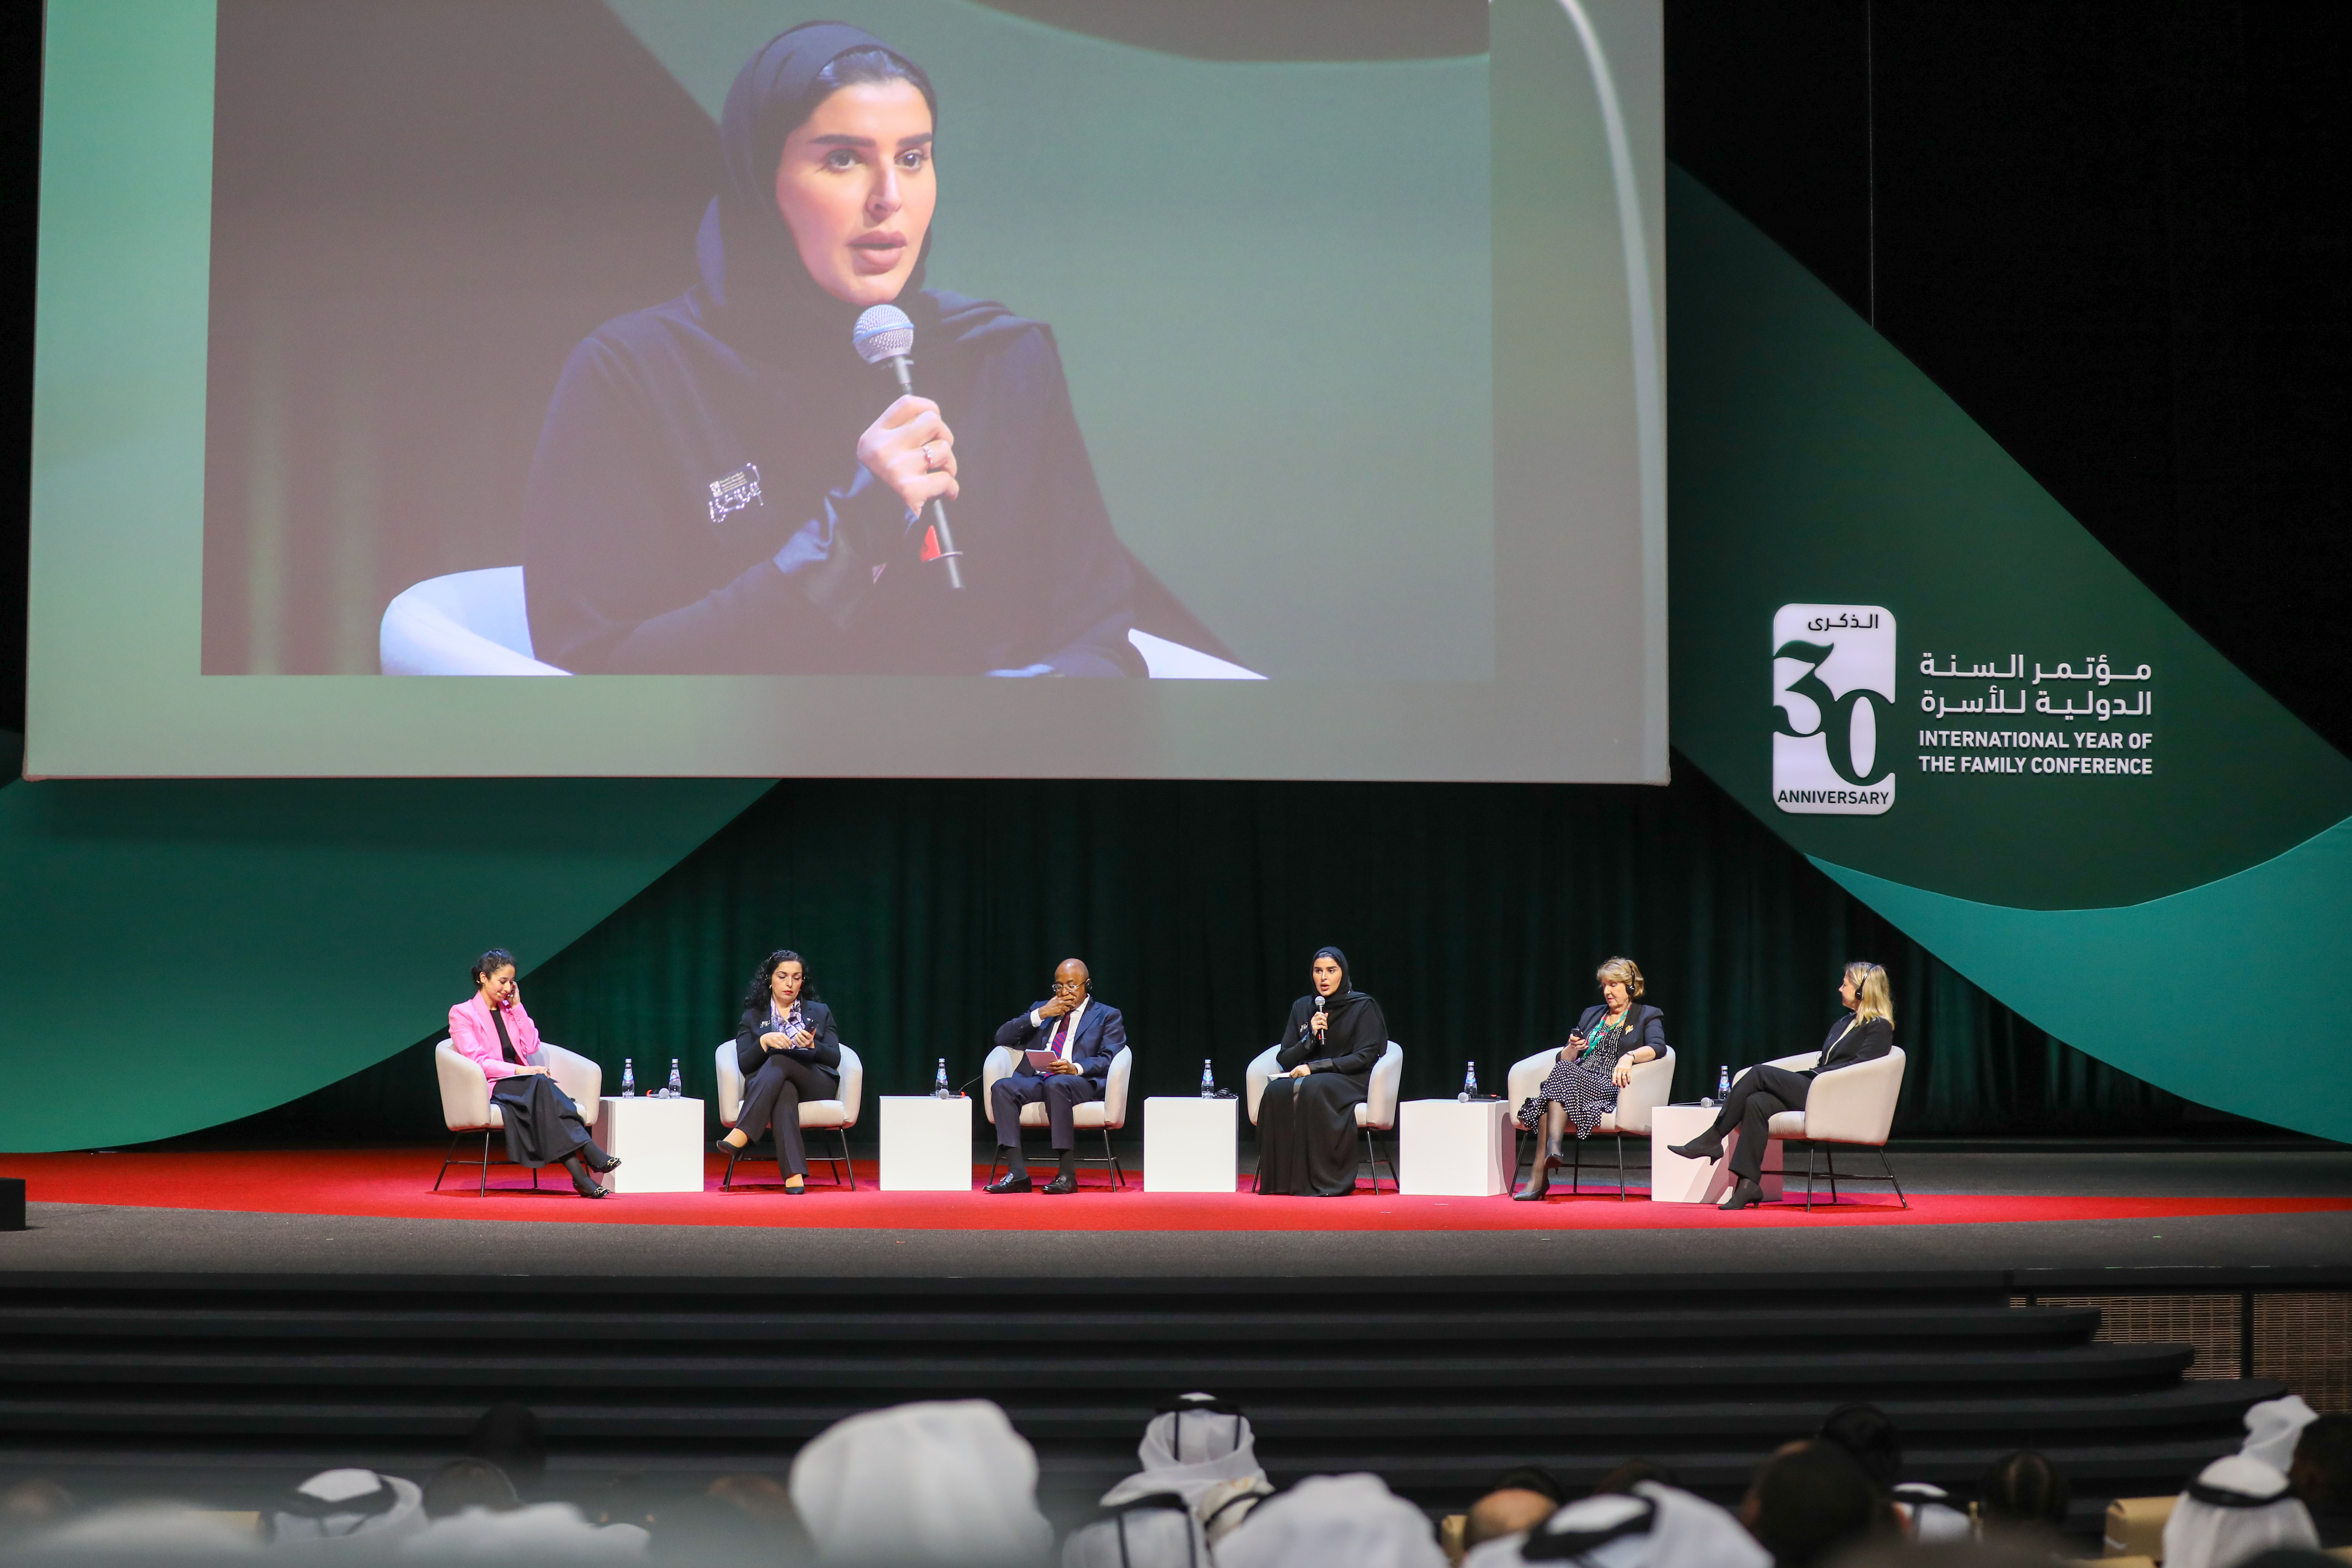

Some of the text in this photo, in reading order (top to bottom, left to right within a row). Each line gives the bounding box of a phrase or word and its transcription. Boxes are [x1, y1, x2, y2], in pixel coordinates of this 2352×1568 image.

[1808, 613, 1878, 631] الذكرى
[1920, 652, 2151, 686] مؤتمر السنة
[1921, 685, 2151, 721] الدولية للأسرة
[1919, 730, 2153, 749] INTERNATIONAL YEAR OF
[1918, 756, 2152, 774] THE FAMILY CONFERENCE
[1777, 790, 1889, 805] ANNIVERSARY
